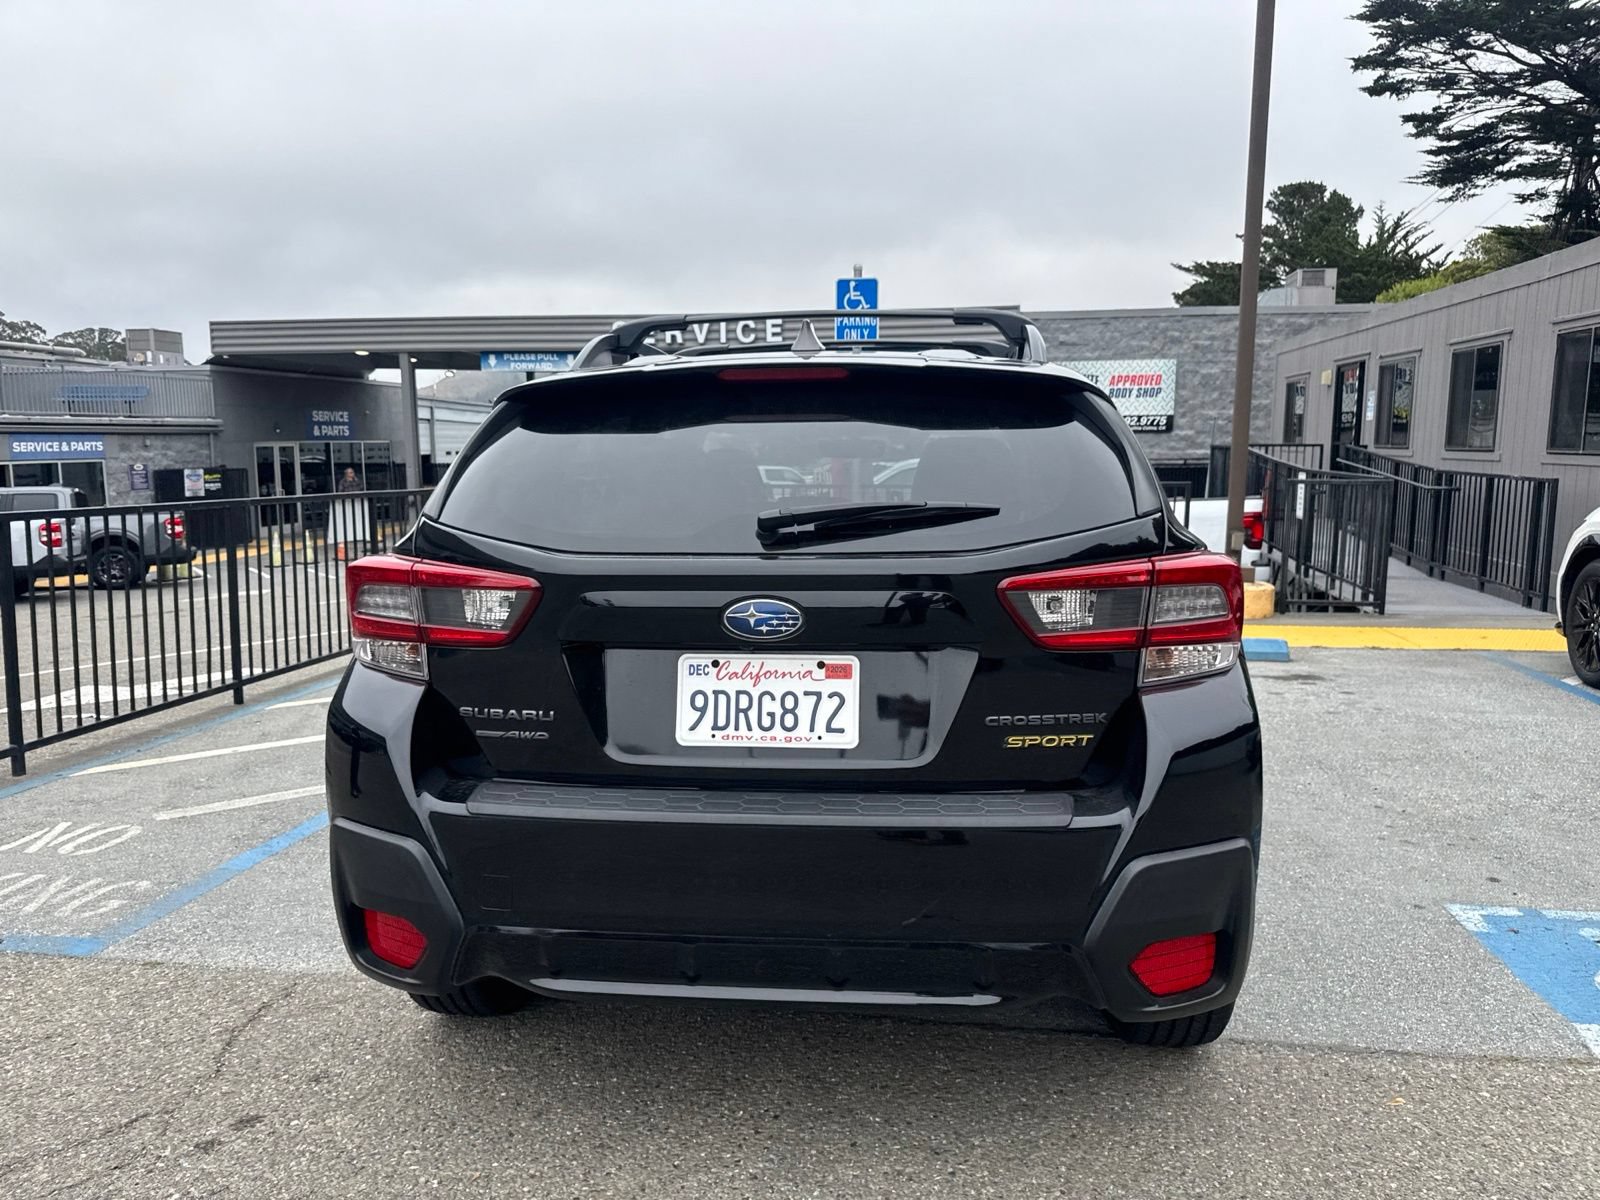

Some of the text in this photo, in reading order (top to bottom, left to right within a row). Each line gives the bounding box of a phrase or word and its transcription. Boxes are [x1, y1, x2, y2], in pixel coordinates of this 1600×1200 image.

[612, 318, 783, 345] RVICE
[844, 328, 869, 340] ONLY
[503, 353, 559, 361] PLEASE PULL
[510, 362, 553, 370] FORWARD
[1109, 374, 1162, 386] APPROVED
[1109, 387, 1162, 398] BODY SHOP
[312, 410, 349, 421] SERVICE
[313, 425, 350, 436] & PARTS
[12, 441, 104, 452] SERVICE & PARTS
[688, 664, 710, 676] DEC
[715, 660, 826, 688] California
[459, 706, 554, 721] SUBARU
[688, 689, 846, 734] 9DRG872
[985, 713, 1107, 726] CROSSTREK
[502, 731, 549, 739] AWD
[721, 733, 813, 743] dmv.ca.gov
[1003, 735, 1094, 748] SPORT
[0, 822, 142, 856] NO
